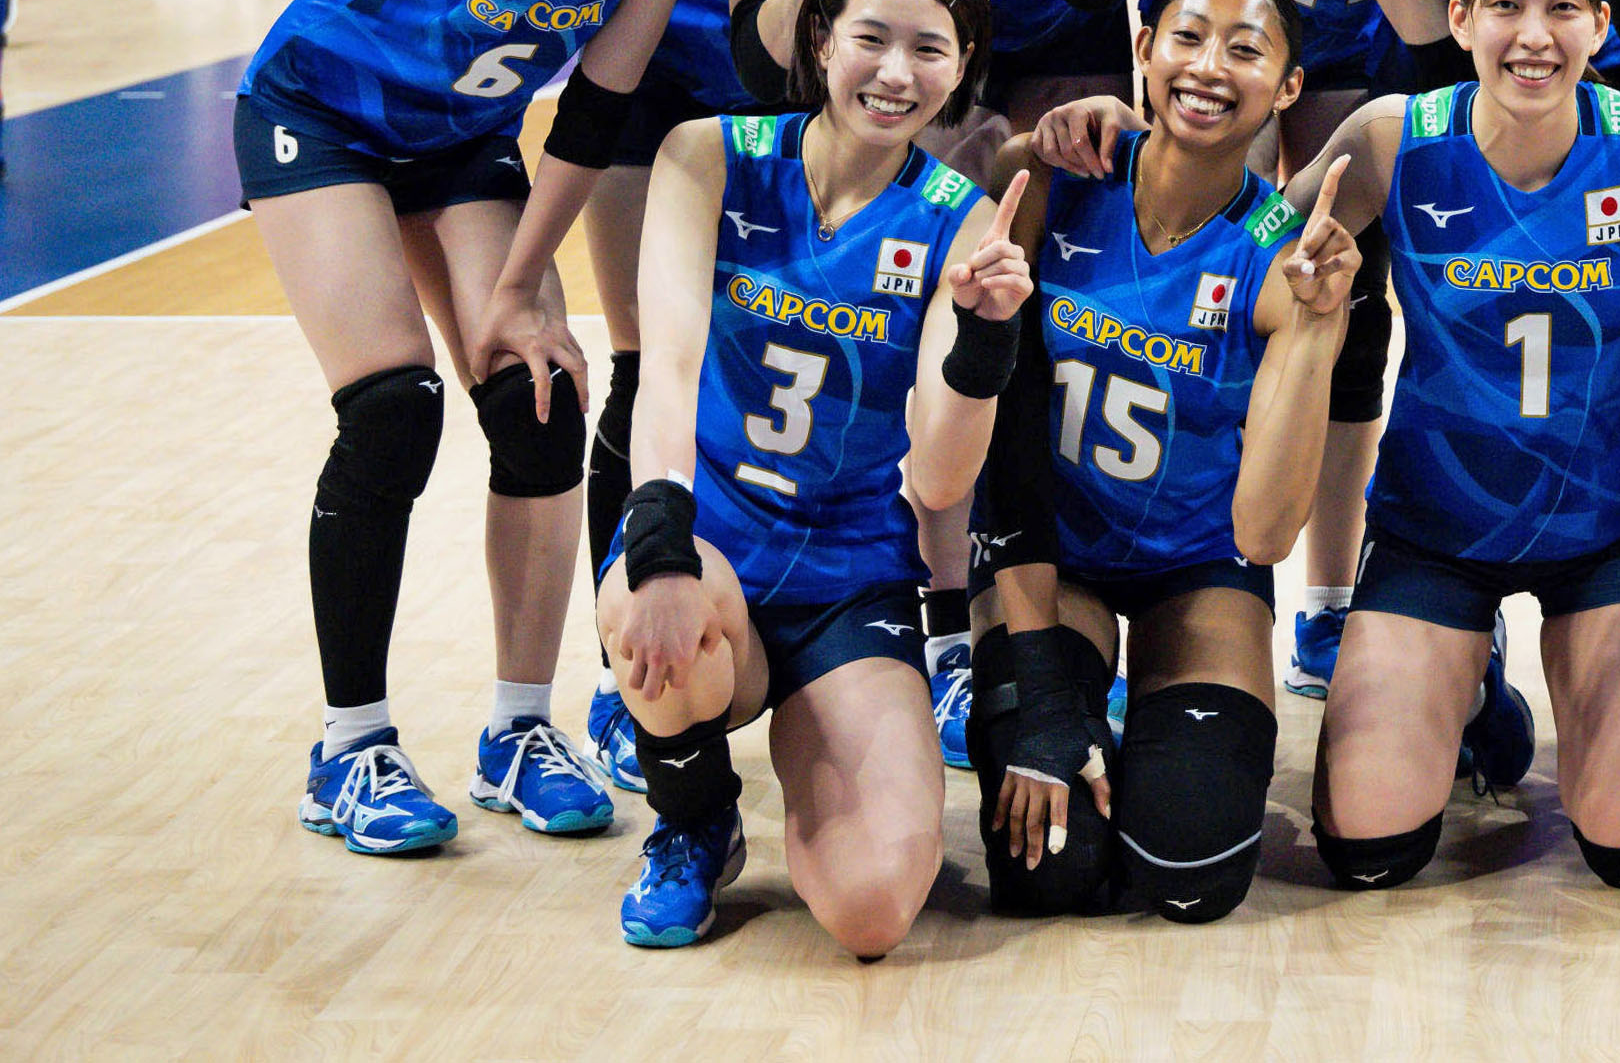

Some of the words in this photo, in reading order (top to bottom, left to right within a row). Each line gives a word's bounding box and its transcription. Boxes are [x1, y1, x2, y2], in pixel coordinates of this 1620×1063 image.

[452, 43, 539, 98] 6
[273, 125, 299, 164] 6
[881, 276, 914, 294] JPN
[1444, 256, 1613, 293] CAPCOM
[727, 273, 891, 343] CAPCOM
[1048, 295, 1208, 377] CAPCOM
[1197, 309, 1227, 327] JPN
[1504, 312, 1552, 419] 1
[744, 340, 830, 457] 3
[1053, 358, 1170, 482] 15
